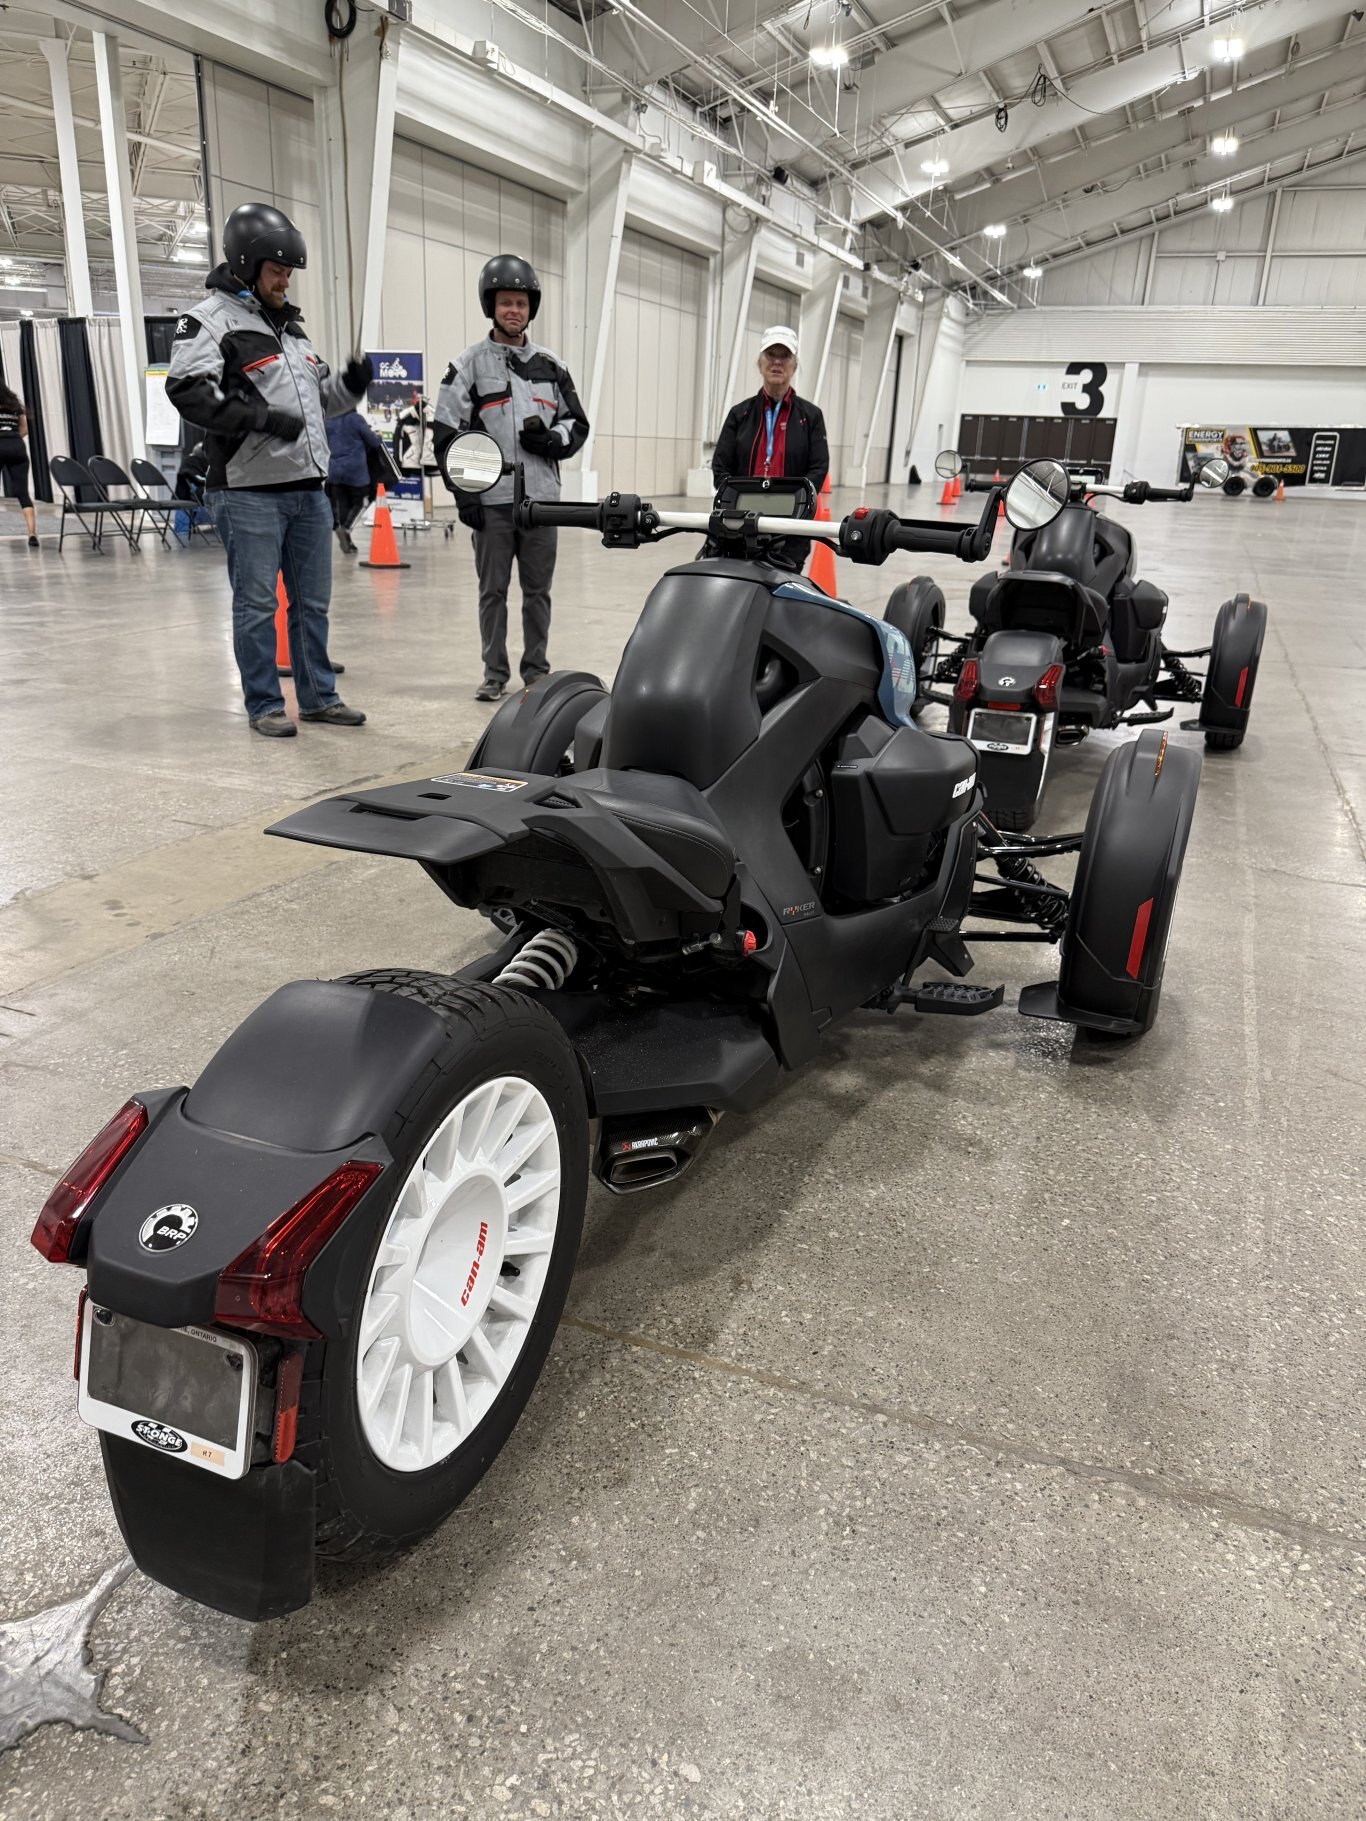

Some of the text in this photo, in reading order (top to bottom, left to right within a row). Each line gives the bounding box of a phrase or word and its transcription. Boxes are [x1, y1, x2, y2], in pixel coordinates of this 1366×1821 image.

[1060, 362, 1108, 418] 3
[1061, 382, 1078, 390] EXIT
[1188, 431, 1224, 439] ENERGY
[156, 1225, 187, 1240] BRP
[460, 1221, 488, 1308] can-am
[190, 1328, 217, 1343] ONTARIO
